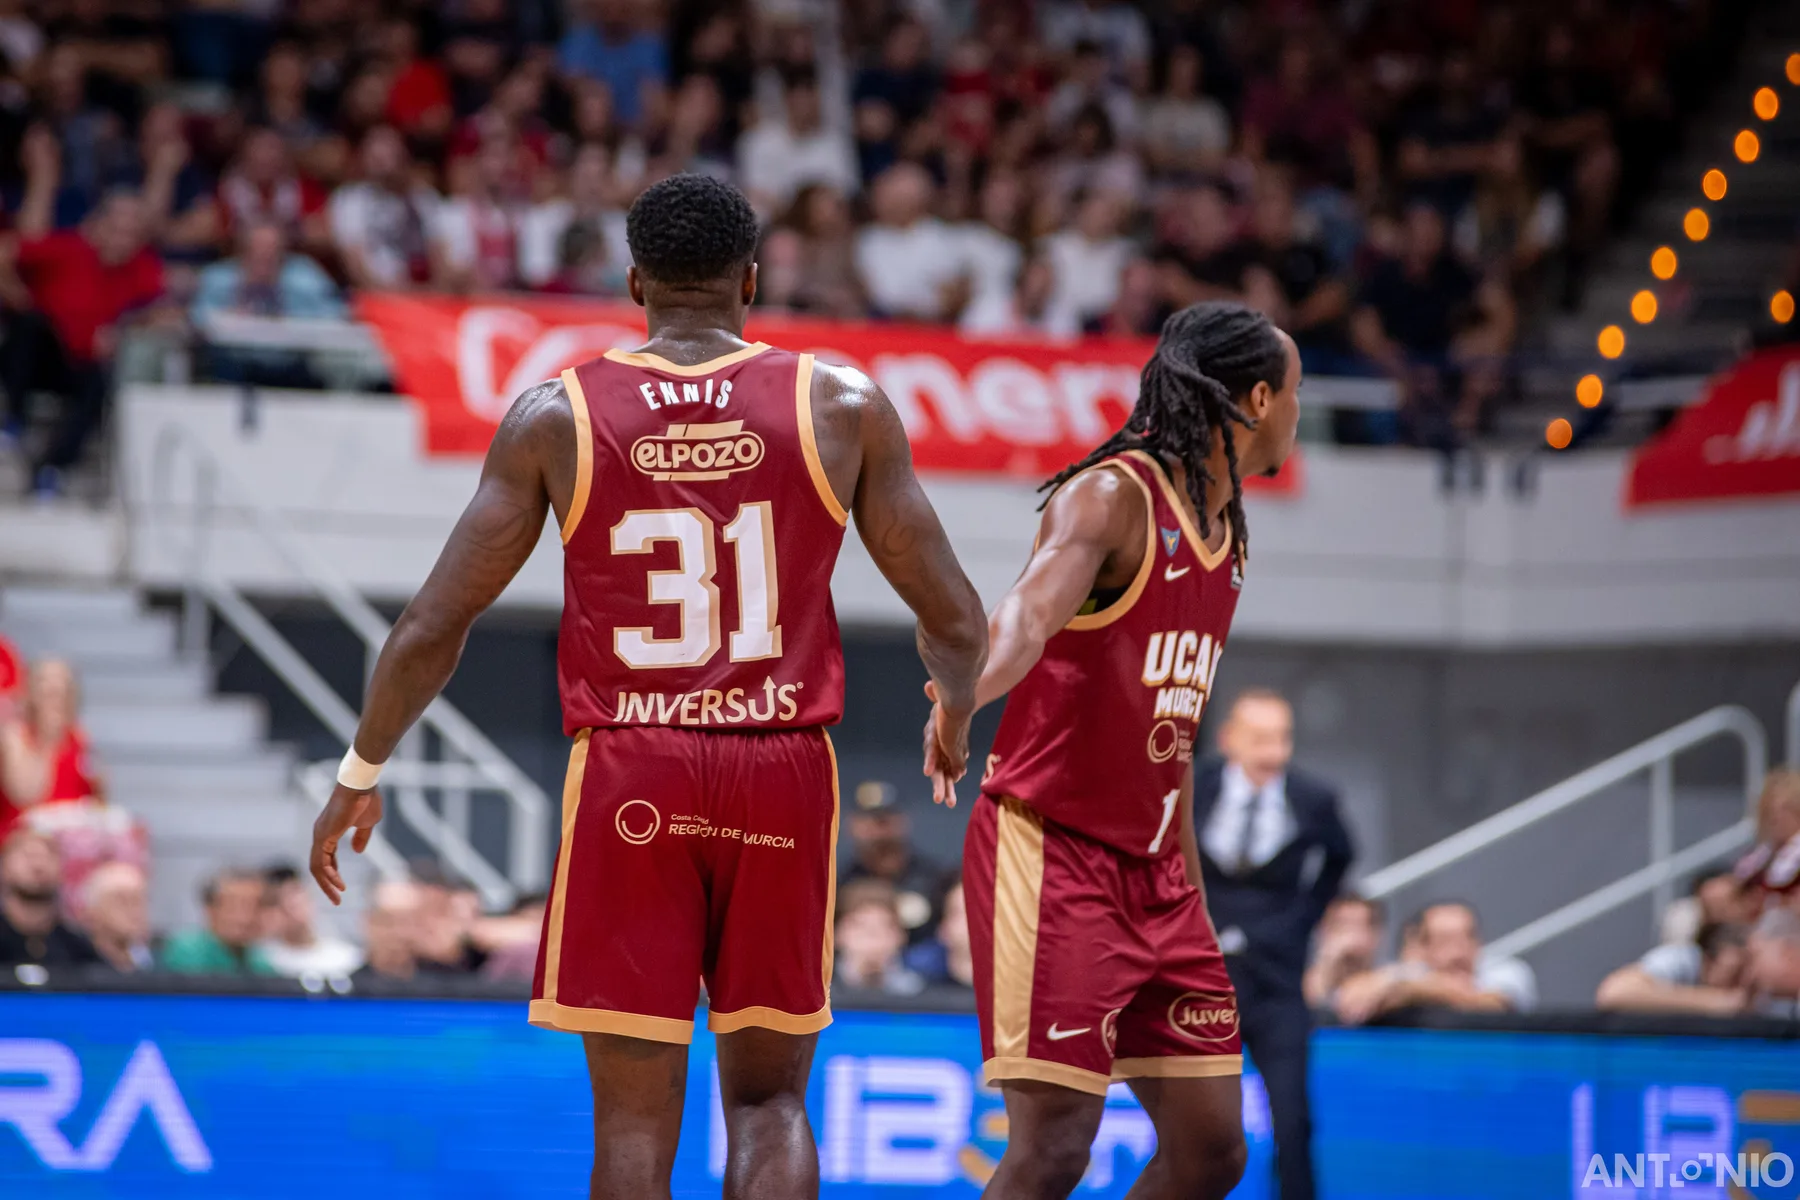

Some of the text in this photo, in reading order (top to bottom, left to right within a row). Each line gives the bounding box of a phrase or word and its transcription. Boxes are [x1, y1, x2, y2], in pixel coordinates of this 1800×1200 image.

[610, 501, 783, 670] 31
[1153, 687, 1204, 723] MURCI
[721, 827, 742, 839] DE
[743, 832, 795, 849] MURCIA
